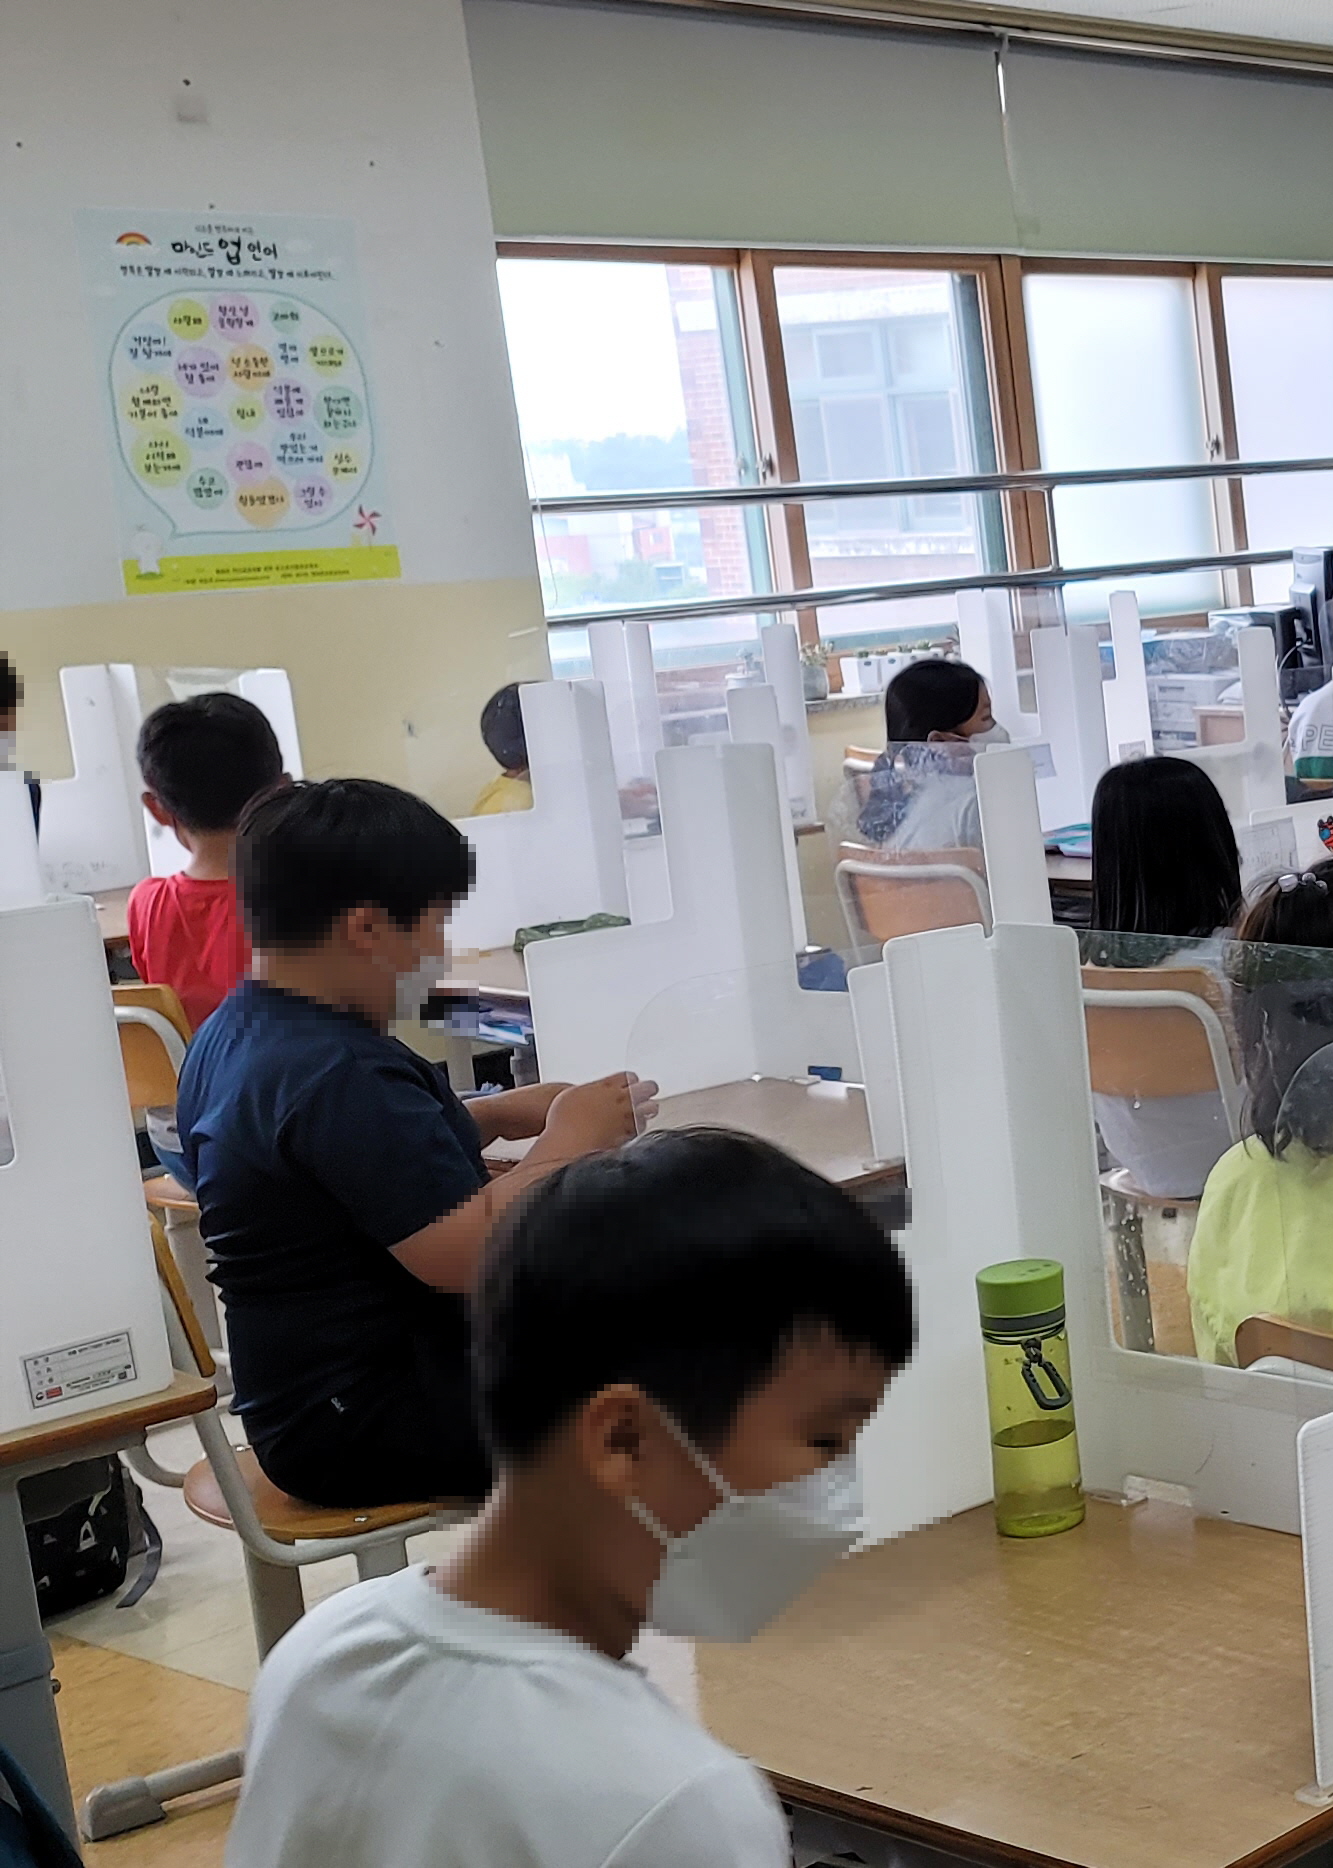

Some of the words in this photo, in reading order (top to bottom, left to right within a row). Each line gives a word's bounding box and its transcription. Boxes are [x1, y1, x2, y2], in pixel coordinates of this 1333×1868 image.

[170, 240, 214, 259] 마인드
[218, 236, 242, 265] 업
[247, 240, 278, 262] 언어
[173, 315, 202, 326] 사랑해
